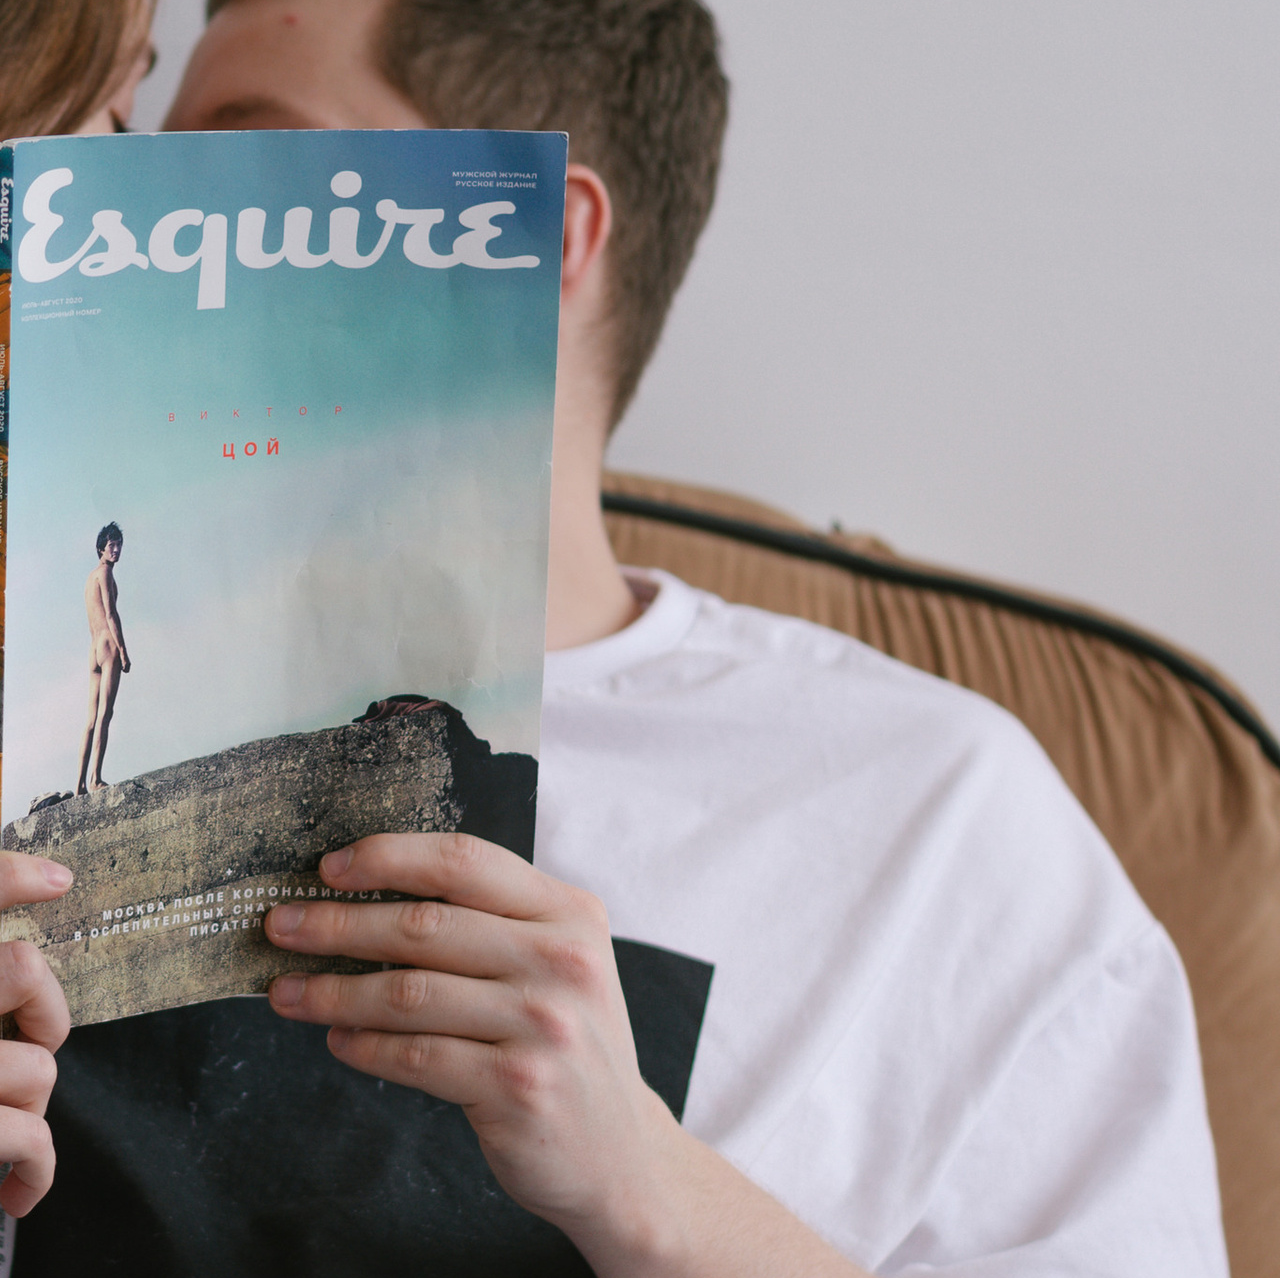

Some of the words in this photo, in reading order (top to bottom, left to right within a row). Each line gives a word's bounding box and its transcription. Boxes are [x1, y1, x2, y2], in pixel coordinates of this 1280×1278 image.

[452, 170, 497, 179] МУЖСКОЙ
[498, 171, 538, 180] ЖУРНАЛ
[455, 180, 494, 188] РУССКОЕ
[496, 181, 537, 189] ИЗДАНИЕ
[18, 167, 541, 311] Esquire
[65, 297, 83, 305] 2020
[76, 309, 101, 317] НОМЕР
[168, 405, 343, 423] ВИКТОР
[222, 437, 280, 460] ЦОЙ
[102, 901, 166, 921] МОСКВА
[174, 891, 225, 909] ПОСЛЕ
[233, 886, 382, 900] КОРОНАВИРУСА
[74, 930, 82, 942] В
[90, 906, 224, 939] ОСЛЕПИТЕЛЬНЫХ
